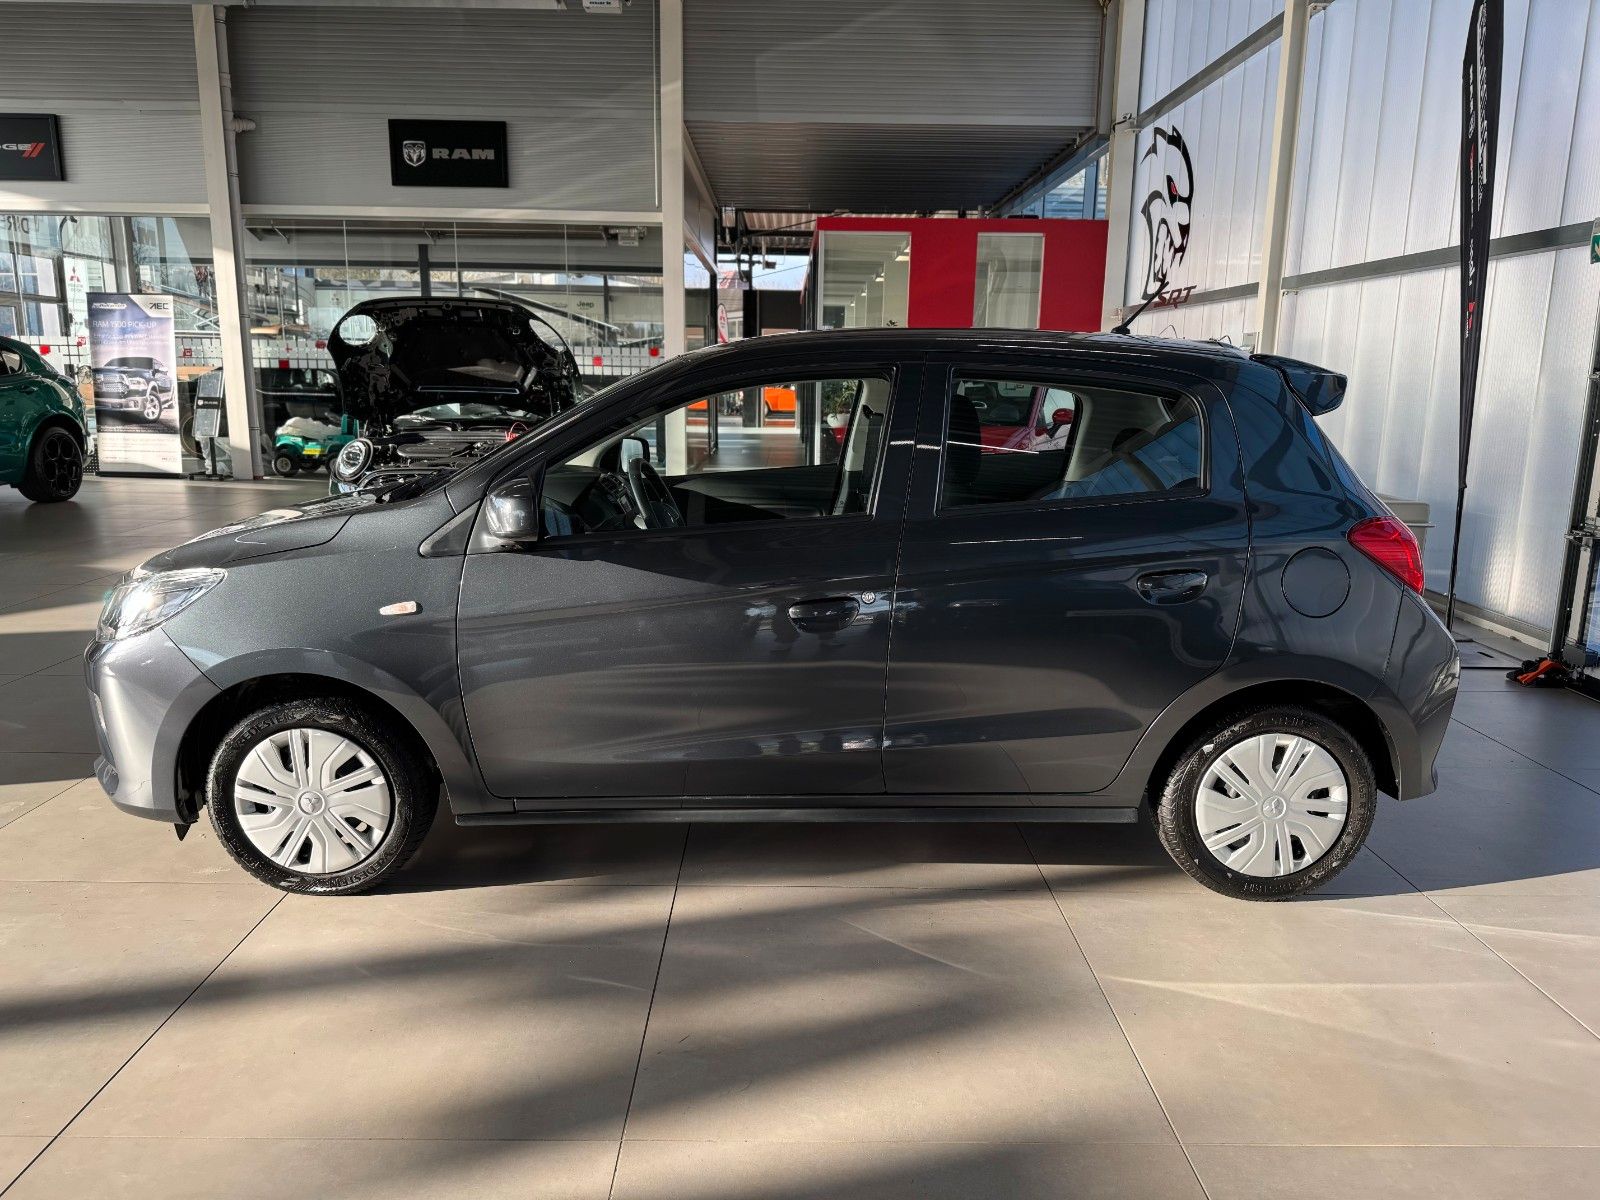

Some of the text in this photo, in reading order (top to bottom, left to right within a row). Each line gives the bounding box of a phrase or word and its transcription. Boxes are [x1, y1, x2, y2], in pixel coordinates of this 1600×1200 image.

[0, 143, 31, 151] GE
[432, 147, 494, 160] RAM
[1153, 285, 1197, 309] SRT
[92, 320, 109, 328] RAM
